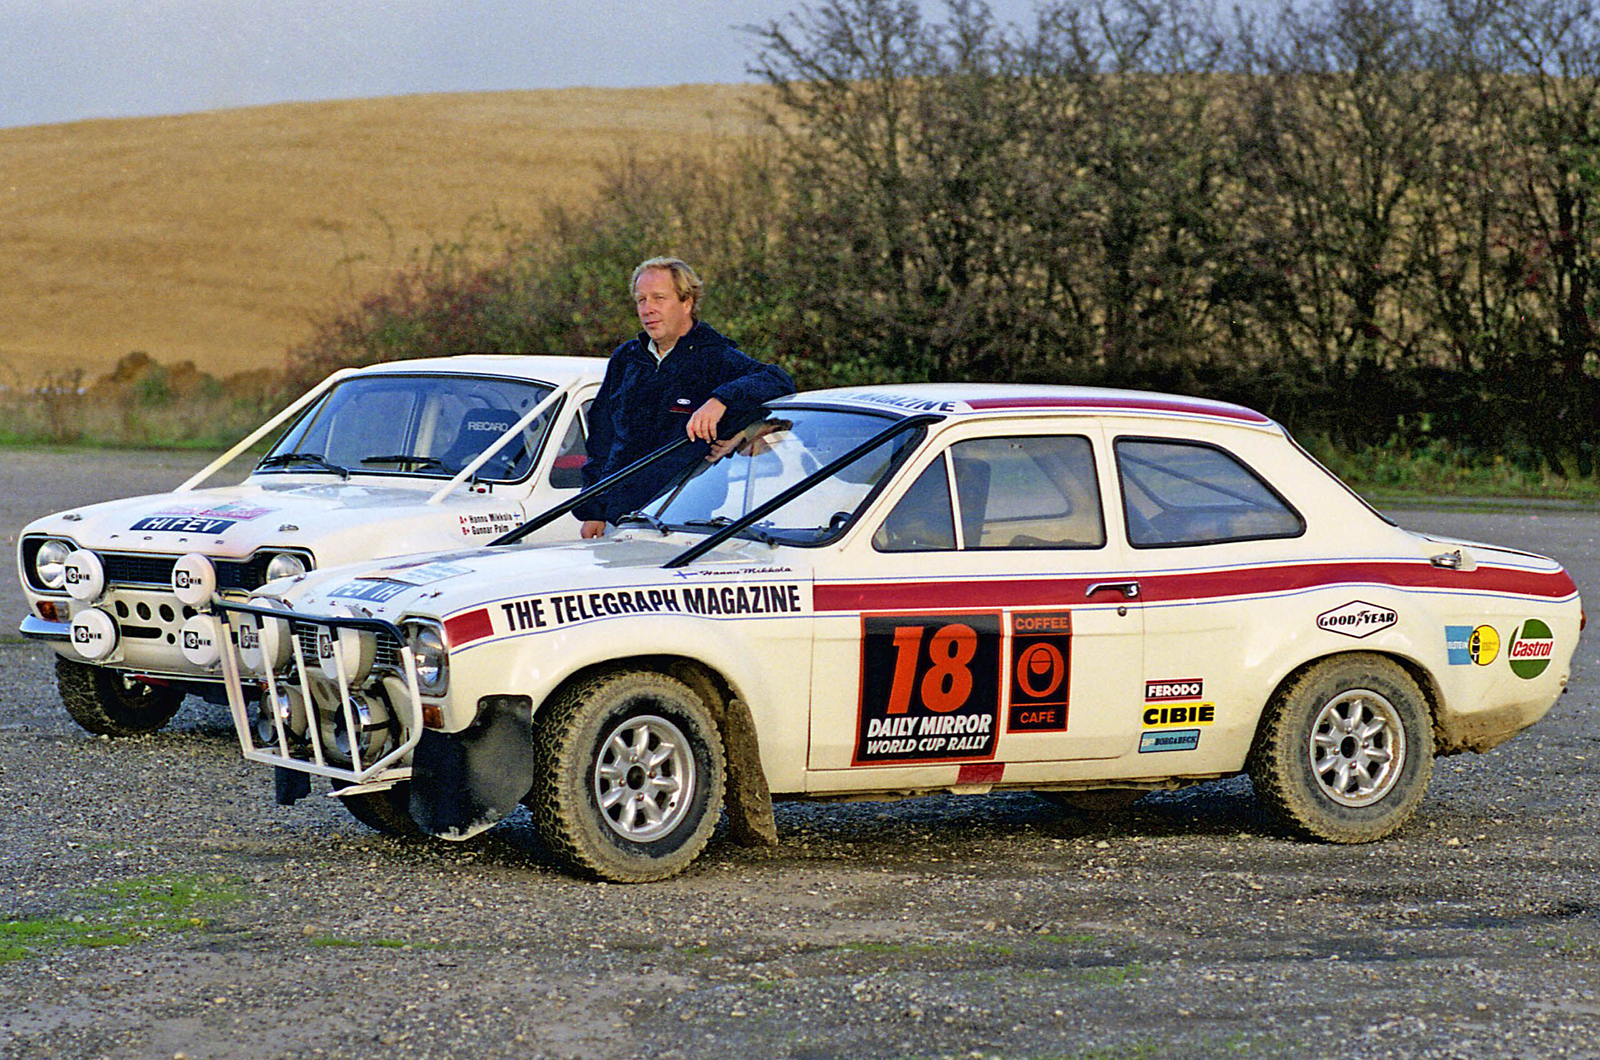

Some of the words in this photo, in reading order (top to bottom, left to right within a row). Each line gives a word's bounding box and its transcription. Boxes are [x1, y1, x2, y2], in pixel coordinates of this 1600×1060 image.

[467, 421, 508, 432] RECARO
[501, 599, 547, 632] THE
[551, 589, 681, 625] TELEGRAPH
[682, 585, 802, 615] MAGAZINE
[1015, 617, 1070, 630] COFFEE
[1512, 641, 1554, 657] Castrol
[886, 623, 978, 714] 18
[1148, 684, 1200, 697] FERODO
[867, 717, 918, 738] DAILY
[918, 714, 992, 736] MIRROR
[866, 739, 917, 754] WORLD
[918, 737, 946, 751] CUP
[946, 735, 990, 751] RALLY
